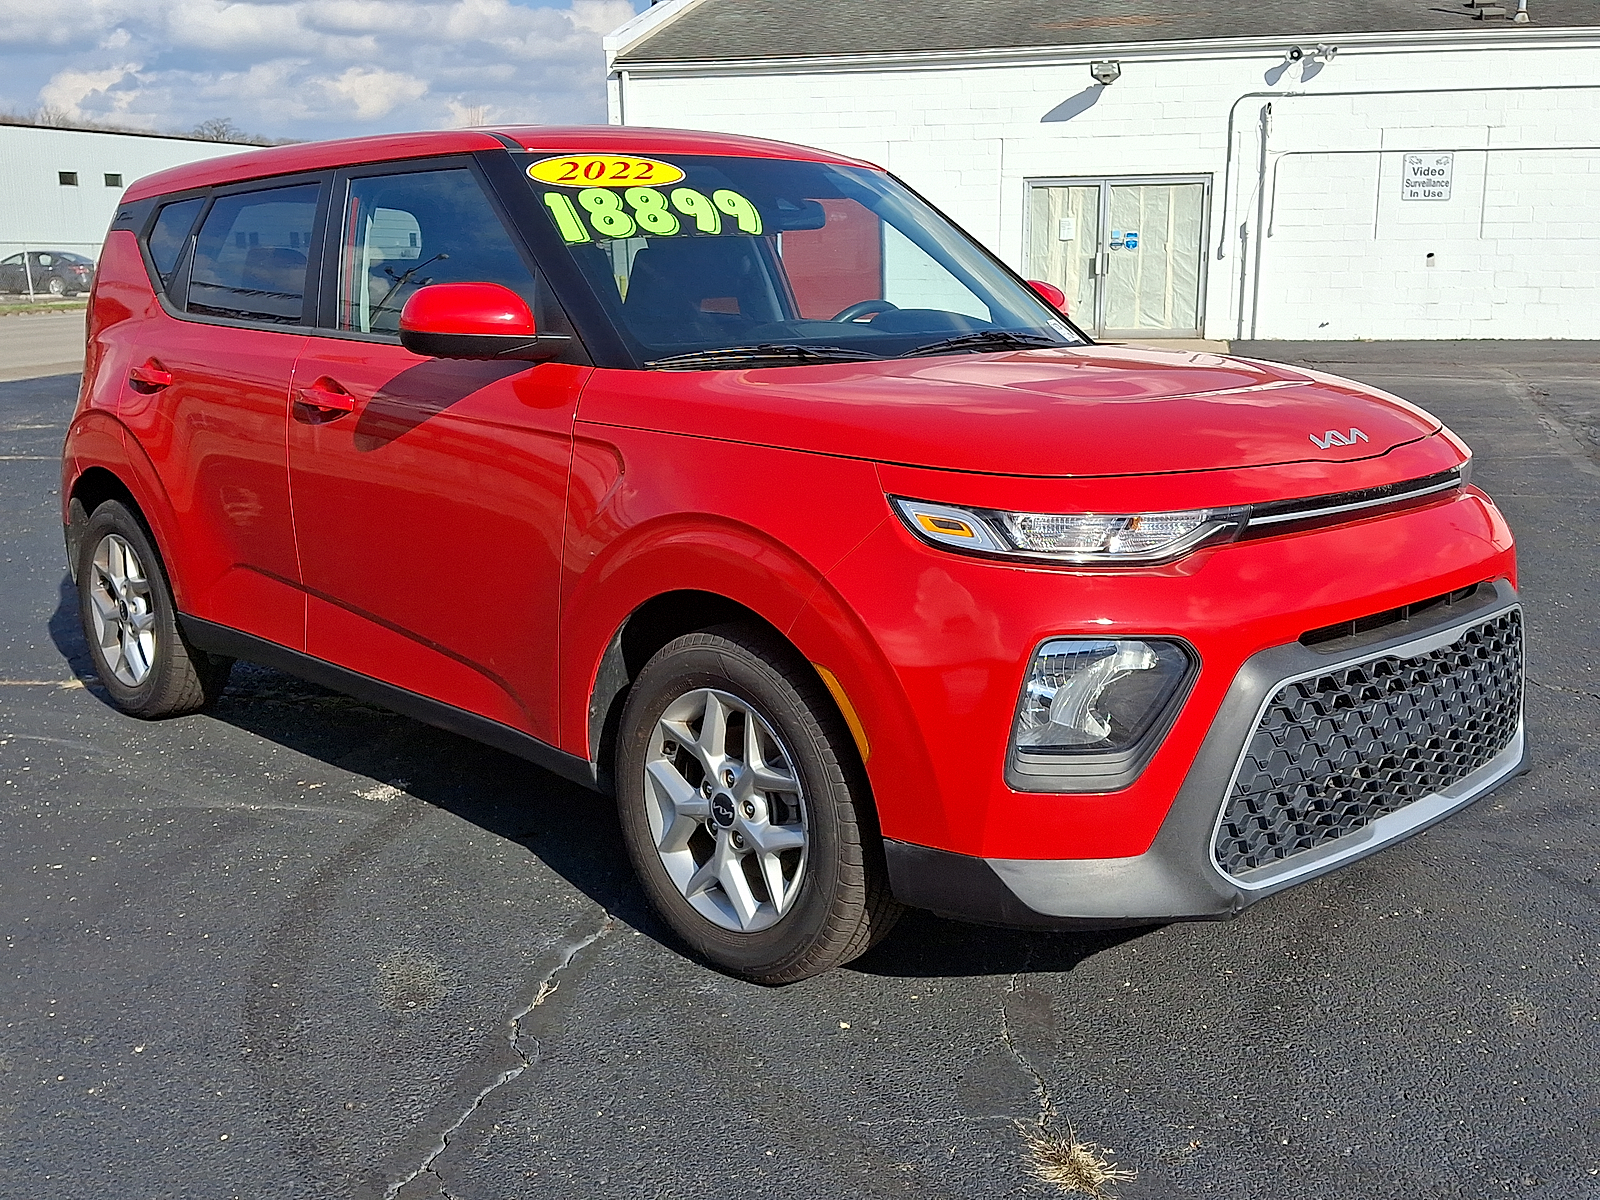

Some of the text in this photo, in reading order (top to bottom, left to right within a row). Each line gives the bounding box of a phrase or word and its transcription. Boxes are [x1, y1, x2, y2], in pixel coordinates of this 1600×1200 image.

[556, 161, 654, 181] 2022
[1412, 167, 1445, 176] Video
[1405, 178, 1450, 187] Surveillance
[543, 187, 763, 243] 18899
[1308, 427, 1369, 449] KIA
